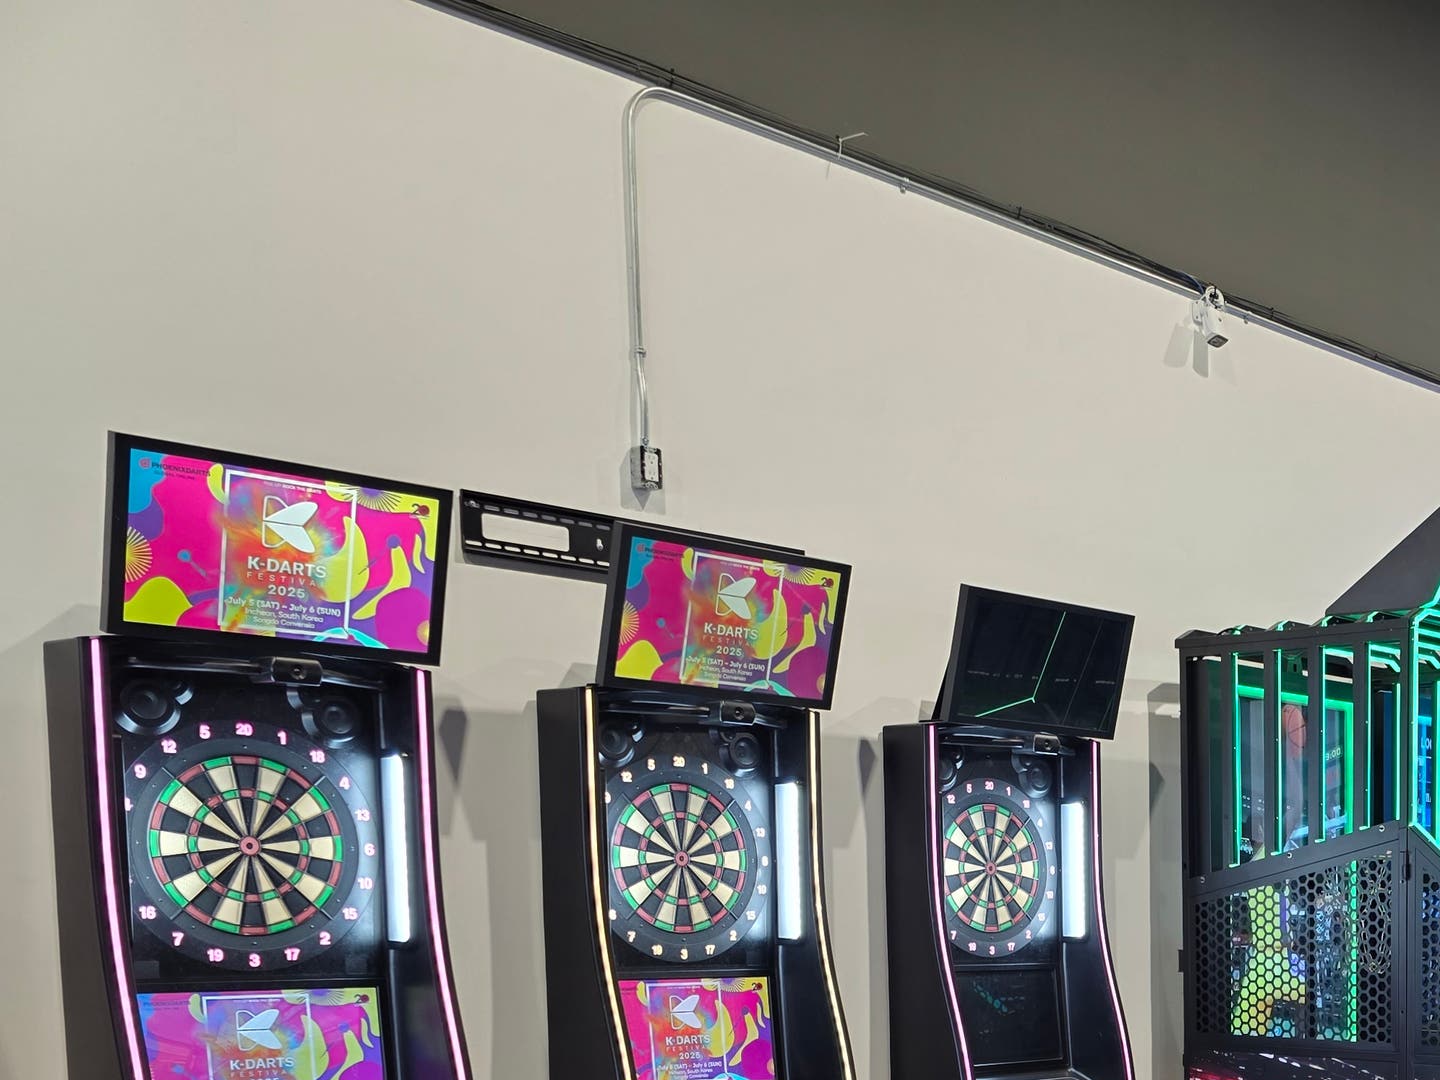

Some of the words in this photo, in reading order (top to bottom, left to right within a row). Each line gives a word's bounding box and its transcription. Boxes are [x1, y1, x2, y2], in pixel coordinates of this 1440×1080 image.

[247, 555, 327, 578] K-DARTS
[246, 571, 319, 587] FESTIVA
[267, 584, 305, 598] 2025
[226, 596, 246, 607] July
[256, 599, 280, 610] (SAT)
[288, 604, 308, 614] July
[309, 605, 315, 613] 6
[316, 606, 341, 618] (SUN)
[278, 611, 301, 621] South
[301, 614, 324, 623] Korea
[703, 622, 759, 640] K-DARTS
[702, 635, 752, 647] FESTIVA
[716, 645, 742, 657] 2025
[199, 724, 211, 740] 5
[235, 723, 253, 737] 20
[277, 730, 287, 746] 1
[160, 739, 177, 754] 12
[309, 750, 326, 764] 18
[672, 755, 686, 768] 20
[133, 763, 147, 779] 9
[647, 758, 656, 771] 5
[701, 762, 709, 775] 1
[339, 775, 351, 790] 4
[620, 771, 633, 783] 12
[744, 799, 752, 811] 4
[355, 809, 370, 822] 13
[364, 843, 376, 856] 6
[357, 877, 373, 890] 10
[756, 885, 767, 895] 10
[138, 905, 157, 920] 16
[342, 908, 358, 921] 15
[745, 910, 757, 921] 15
[171, 931, 185, 947] 7
[319, 931, 332, 946] 2
[626, 930, 637, 943] 7
[729, 928, 738, 942] 2
[206, 948, 224, 962] 19
[284, 947, 301, 961] 17
[680, 948, 689, 960] 3
[704, 944, 716, 955] 17
[248, 953, 261, 968] 3
[665, 1034, 711, 1046] K-DARTS
[679, 1051, 701, 1060] 2025
[229, 1056, 295, 1071] K-DARTS
